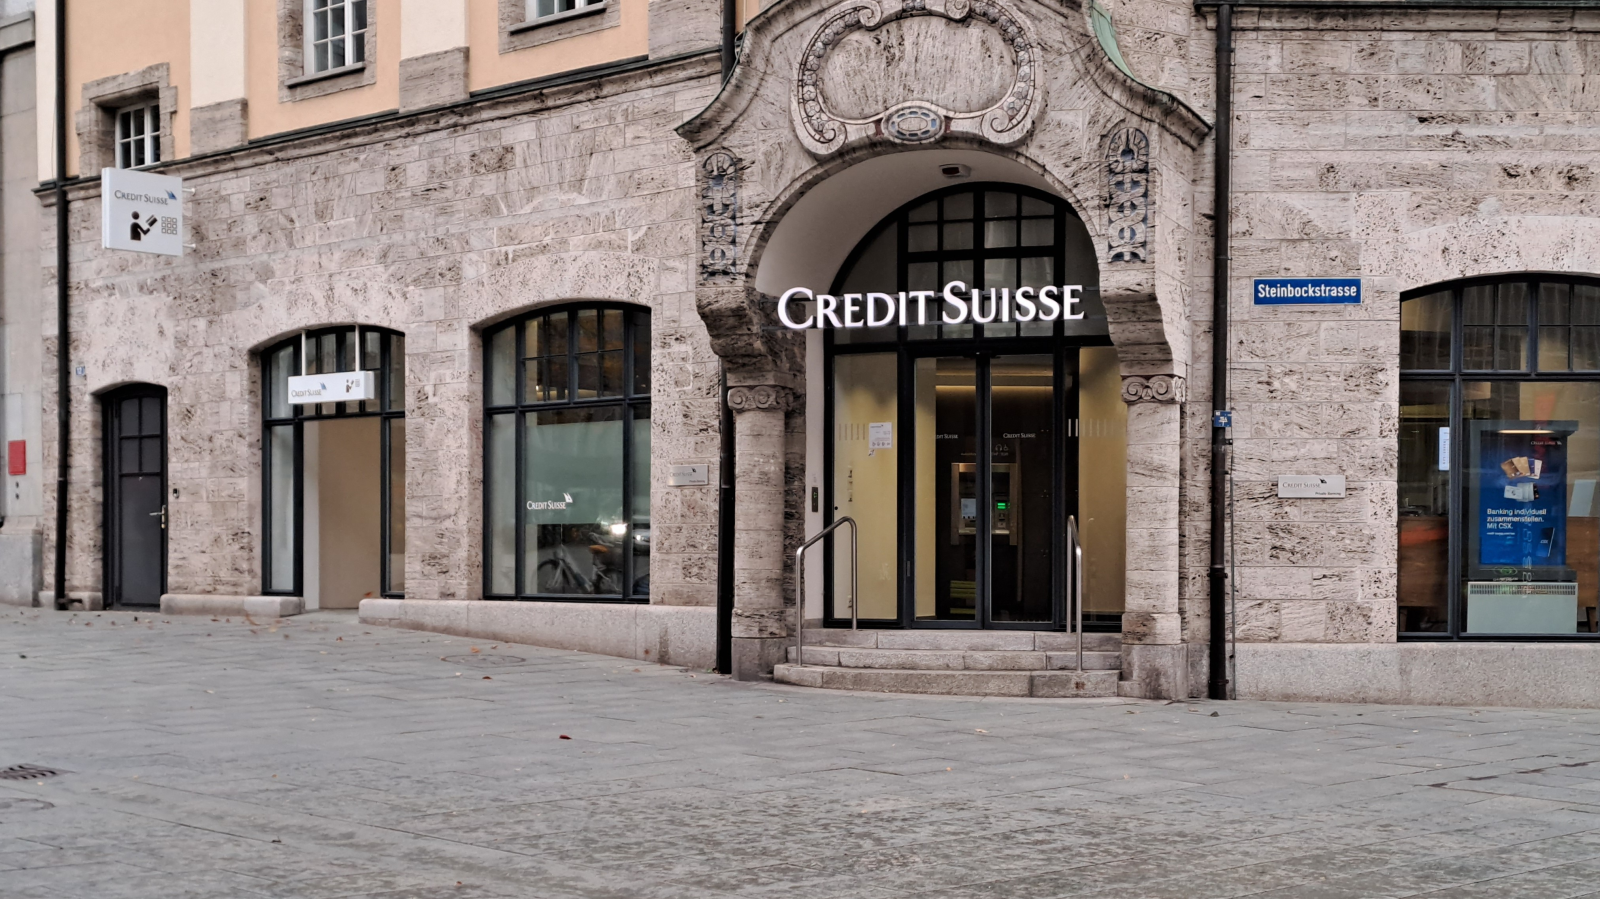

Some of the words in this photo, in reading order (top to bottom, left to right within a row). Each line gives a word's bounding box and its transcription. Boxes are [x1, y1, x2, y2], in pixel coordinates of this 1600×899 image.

[114, 189, 142, 201] CREDIT
[143, 194, 168, 206] SUISSE
[1257, 283, 1357, 298] Steinbockstrasse
[777, 286, 935, 329] CREDIT
[941, 280, 1085, 324] SUISSE
[526, 500, 547, 510] CREDIT
[547, 500, 566, 510] SUISSE
[1486, 508, 1513, 516] Banking
